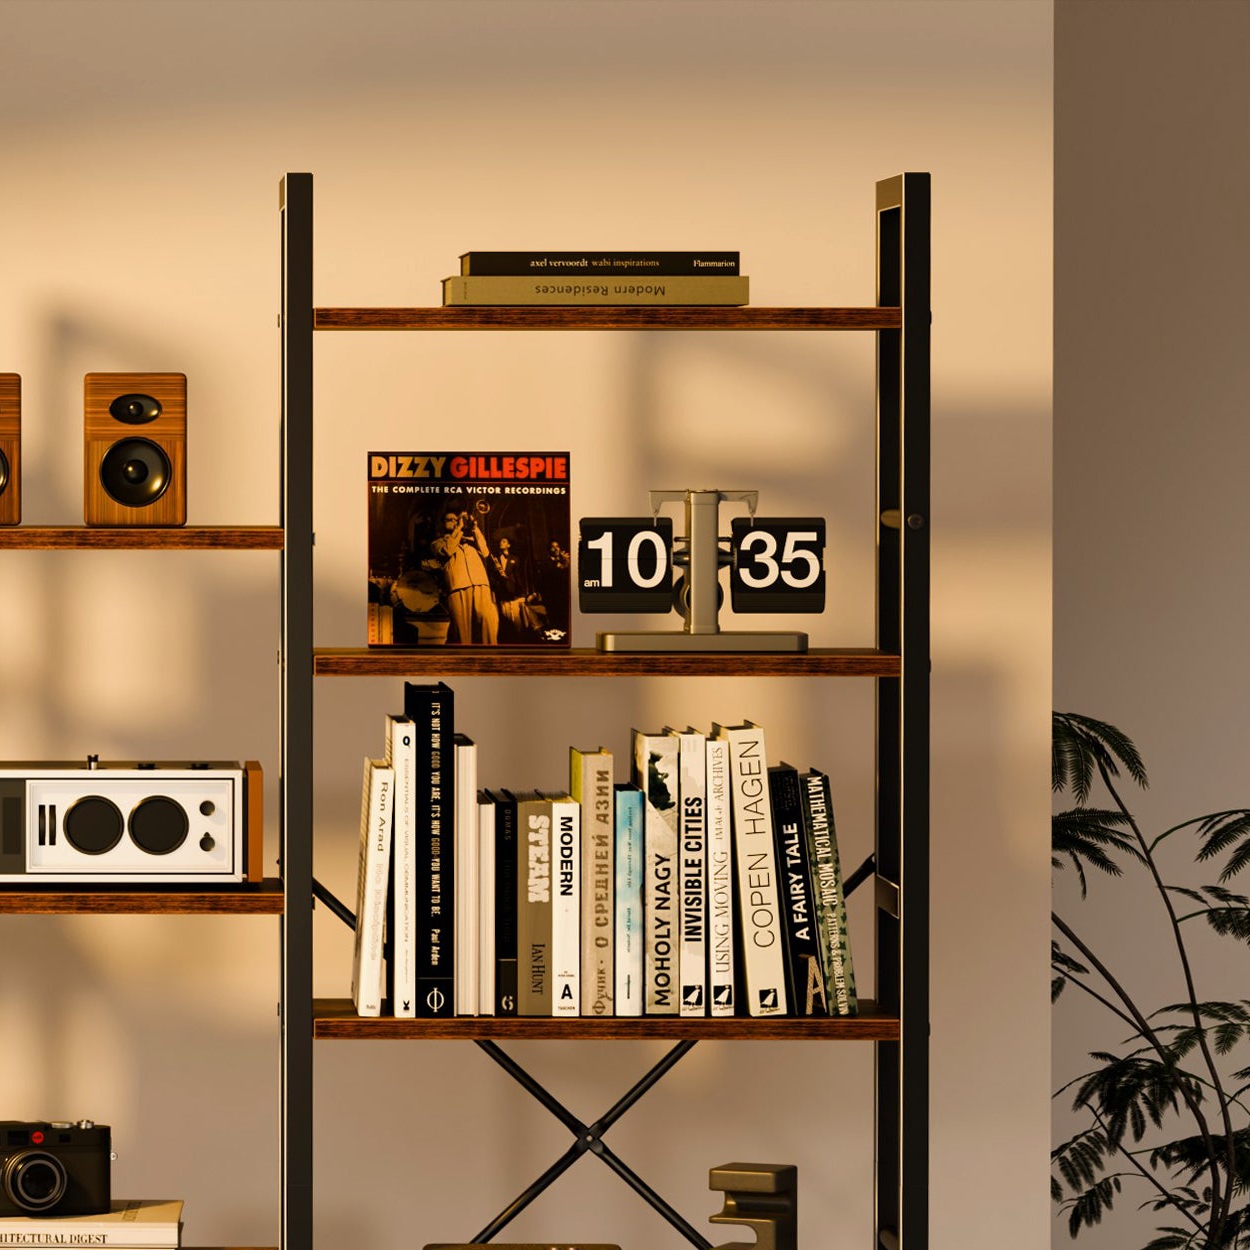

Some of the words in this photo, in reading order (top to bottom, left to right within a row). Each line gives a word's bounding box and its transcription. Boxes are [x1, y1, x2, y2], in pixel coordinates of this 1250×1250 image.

[530, 258, 547, 267] axel
[549, 258, 588, 267] vervoordt
[592, 258, 611, 267] wabi
[613, 258, 660, 268] inspirations
[535, 285, 608, 296] Residences
[614, 285, 666, 296] Modern
[372, 456, 446, 478] DIZZY
[450, 457, 566, 479] GILLESPIE
[372, 486, 388, 494] THE
[392, 486, 440, 494] COMPLETE
[444, 486, 462, 494] RCA
[466, 486, 502, 494] VICTOR
[505, 487, 566, 495] RECORDINGS
[587, 531, 667, 588] 10
[739, 531, 820, 588] 35
[584, 578, 600, 588] am
[431, 702, 441, 716] IT'S
[431, 718, 441, 731] NOT
[431, 734, 441, 749] HOW
[431, 771, 441, 785] YOU
[712, 748, 724, 802] ARCHIVES
[738, 740, 766, 836] HAGEN
[380, 782, 389, 812] Ron
[596, 770, 609, 825] АЗИИ
[431, 820, 441, 835] HOW
[685, 797, 702, 852] CITIES
[806, 776, 833, 861] MATHEMATICAL
[377, 817, 387, 852] Arad
[782, 823, 802, 868] TALE
[431, 858, 441, 871] YOU
[528, 815, 550, 904] STEAM
[560, 816, 572, 896] MODERN
[431, 874, 441, 892] WANT
[592, 834, 609, 927] СРЕДНЕЙ
[654, 854, 671, 910] NAGY
[713, 852, 730, 918] MOVING
[818, 863, 838, 906] MOSAIC
[431, 896, 441, 904] TO
[685, 858, 702, 942] INVISIBLE
[748, 852, 775, 948] COPEN
[788, 872, 808, 923] FAIRY
[431, 928, 440, 943] Paul
[796, 928, 810, 941] A
[826, 912, 841, 949] PATTERNS
[431, 946, 440, 966] Arden
[532, 944, 545, 962] IAN
[654, 914, 670, 1006] MOHOLY
[714, 924, 730, 973] USING
[532, 965, 545, 995] HUNT
[831, 957, 846, 988] PROBLEM
[561, 984, 573, 1000] A
[592, 968, 612, 1015] Фучик
[69, 1234, 108, 1244] DIGEST
